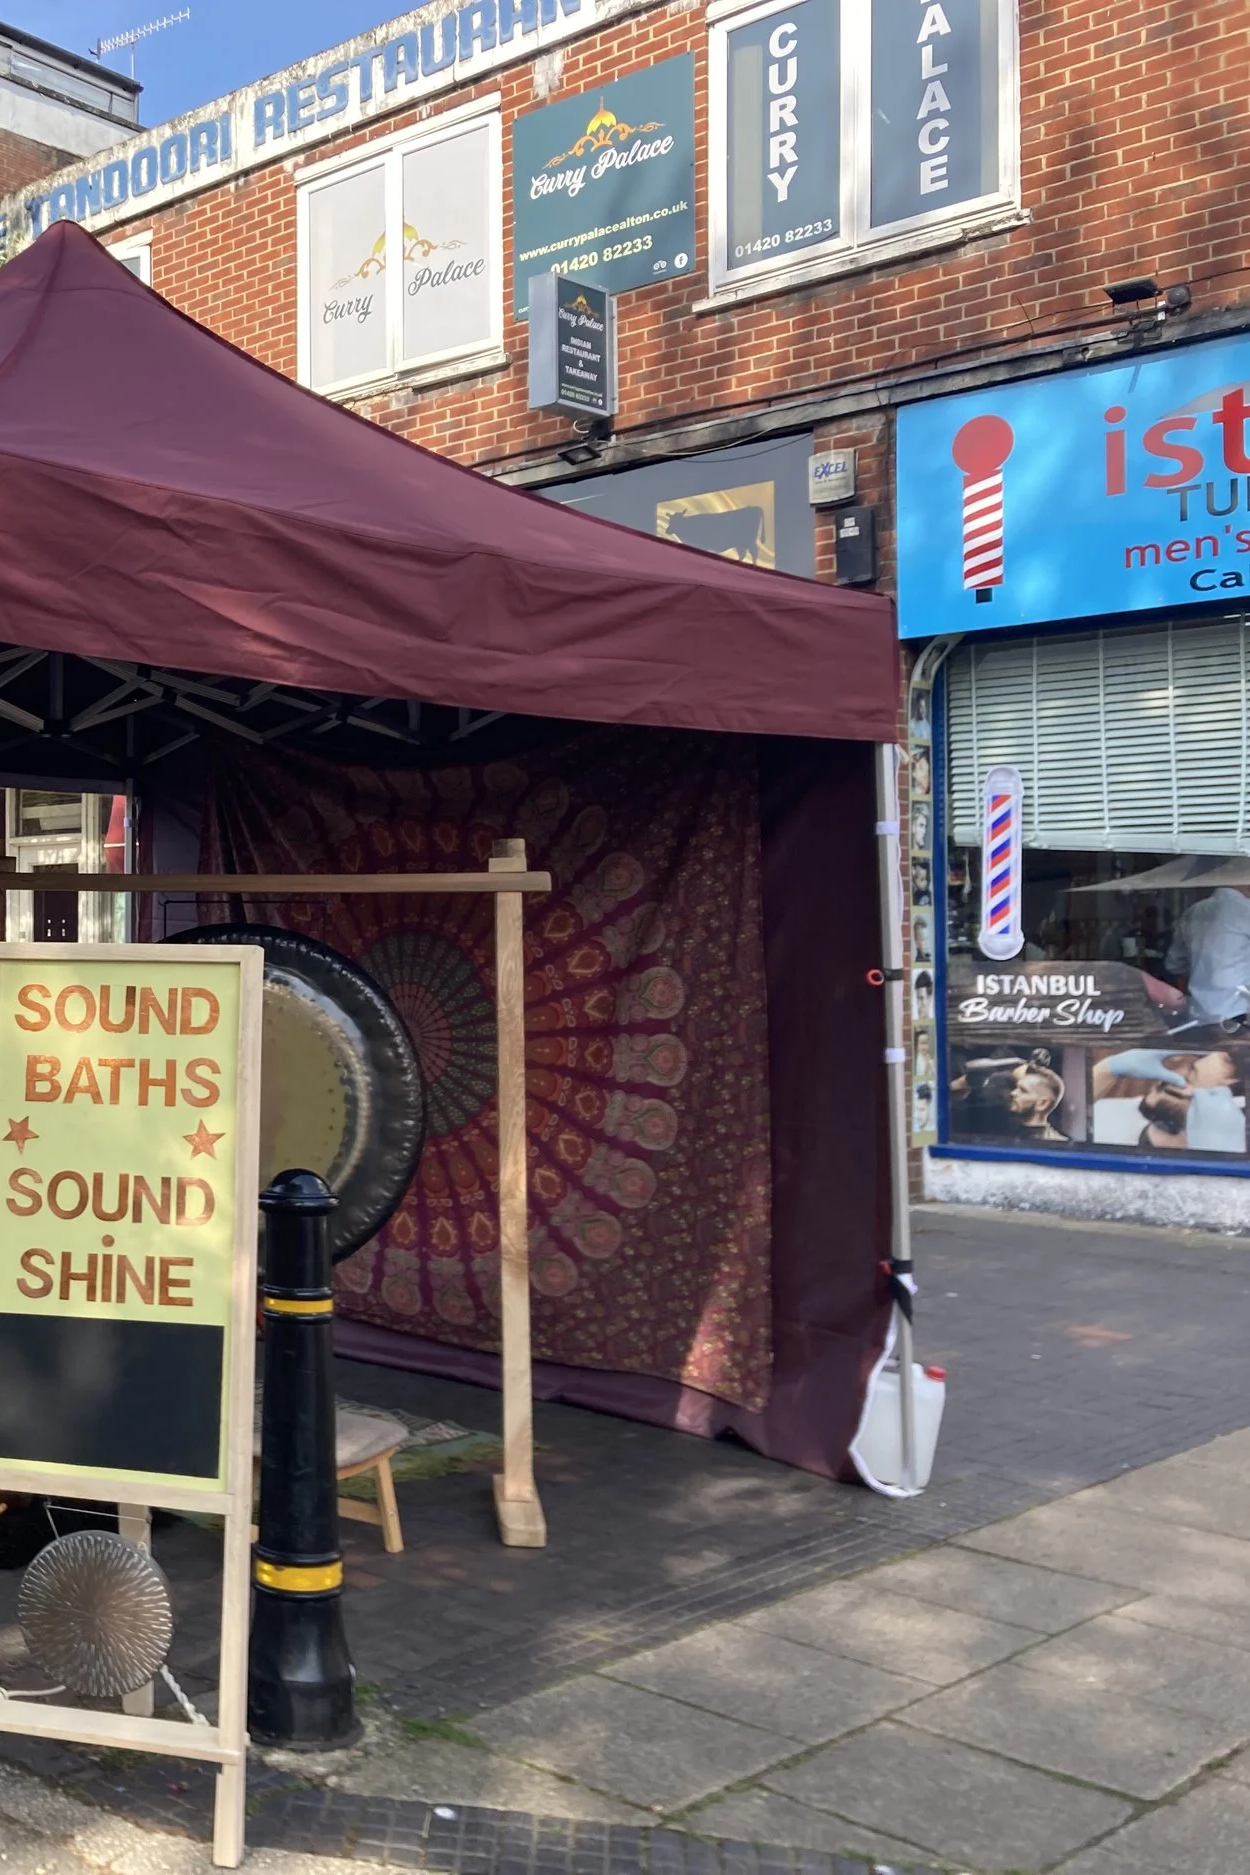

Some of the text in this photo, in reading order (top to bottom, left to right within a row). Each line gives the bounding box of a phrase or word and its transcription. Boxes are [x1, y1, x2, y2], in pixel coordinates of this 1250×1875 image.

[767, 22, 798, 203] CURRY
[917, 0, 952, 195] ALACE
[26, 113, 232, 237] TANDOORI
[530, 135, 675, 200] Curry Palace
[519, 200, 688, 262] www.currypalacealton.co.uk
[735, 218, 833, 258] 01420 82233
[551, 235, 654, 275] 01420 82233
[323, 258, 486, 324] Curry Palace
[562, 344, 601, 362] RESTAURANT
[570, 337, 592, 350] INDIAN
[565, 365, 598, 382] TAKEAWAY
[814, 461, 848, 479] EXCEL
[1166, 476, 1250, 522] TU
[1125, 525, 1250, 569] men's
[976, 974, 1101, 997] ISTANBUL
[14, 983, 221, 1036] SOUND
[958, 997, 1126, 1033] Barber Shop
[24, 1054, 221, 1108] BATHS
[5, 1167, 216, 1227] SOUND
